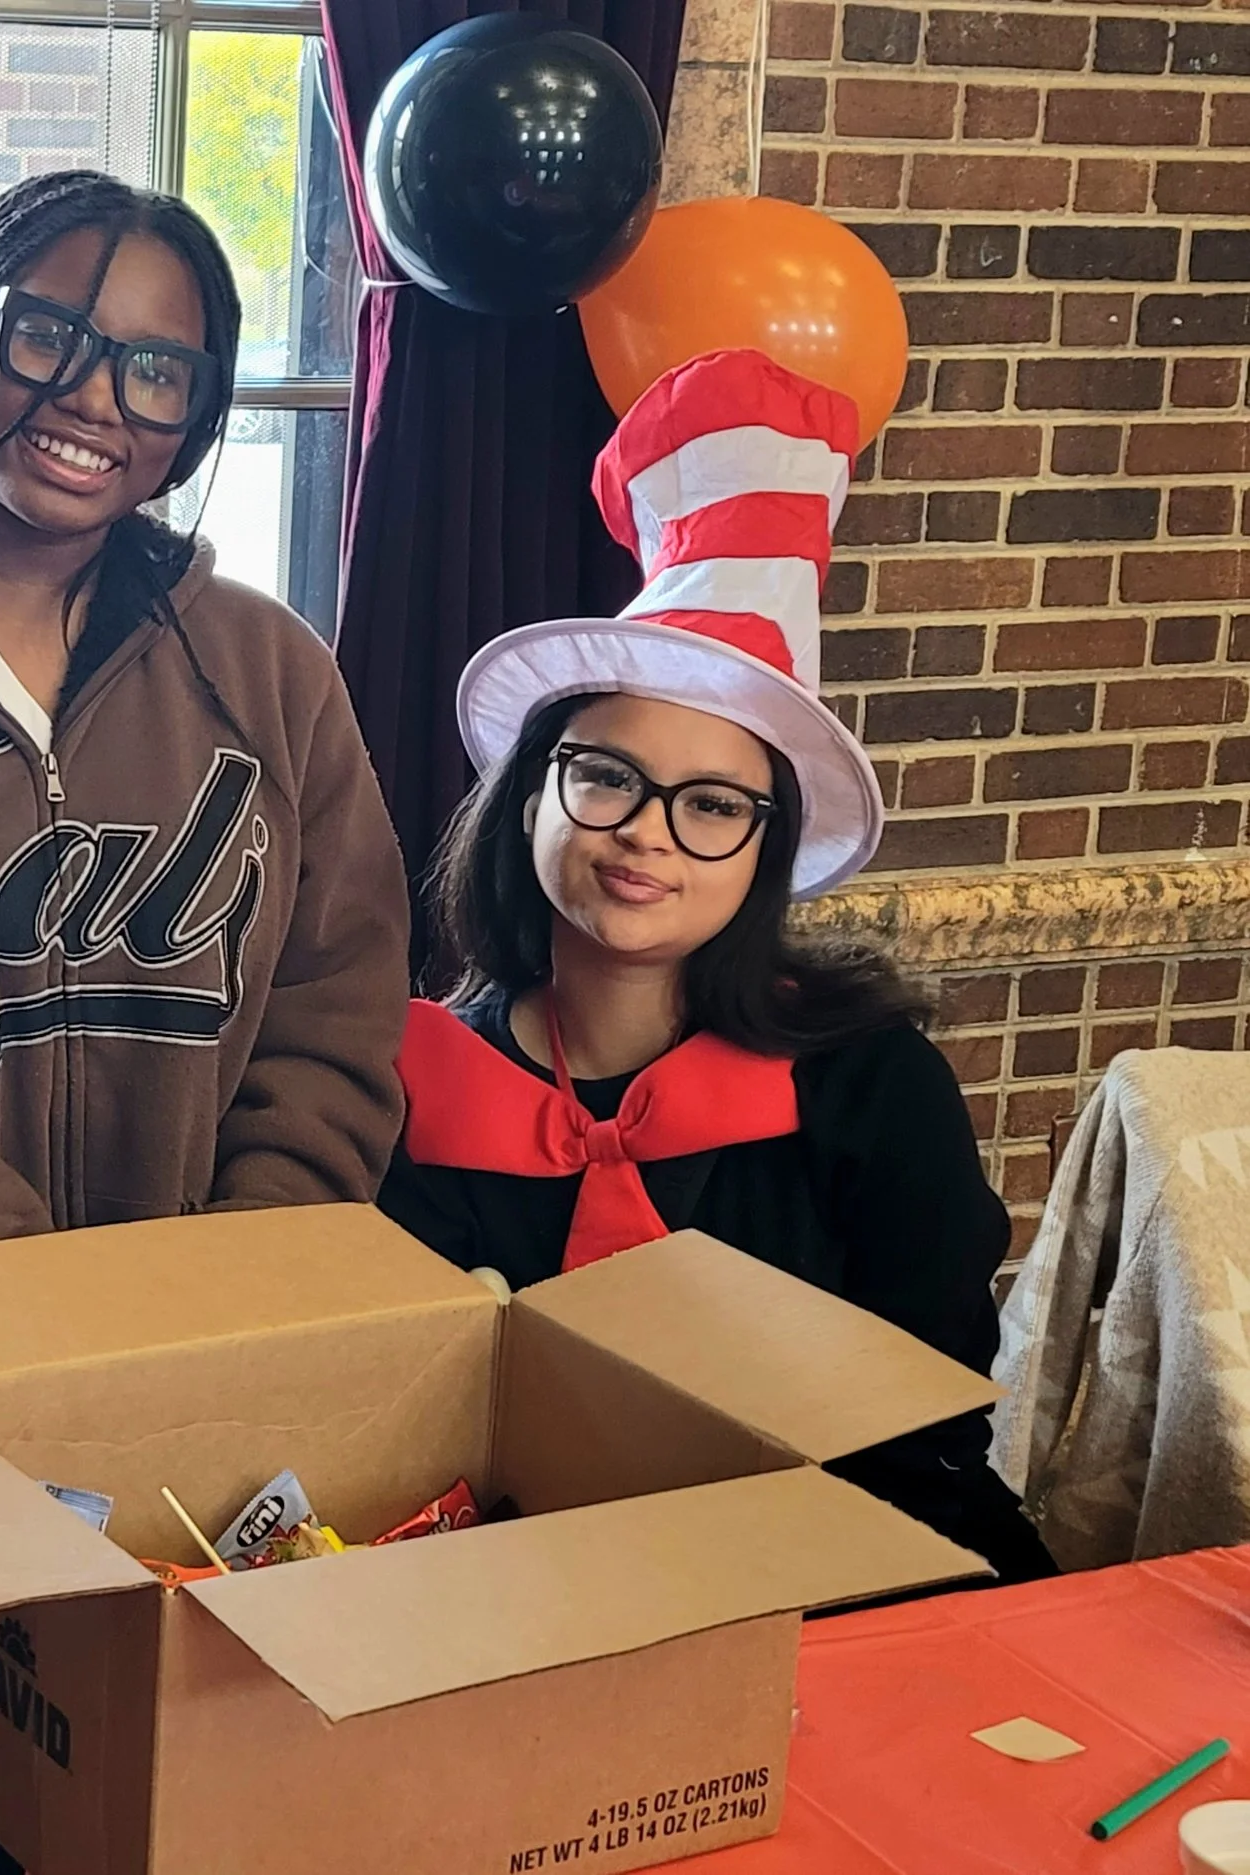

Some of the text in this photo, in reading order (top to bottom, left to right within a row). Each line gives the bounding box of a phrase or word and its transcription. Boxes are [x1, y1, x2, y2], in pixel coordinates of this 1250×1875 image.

[239, 1497, 283, 1545] Fini
[587, 1766, 769, 1828] 4-19.5 OZ CARTONS
[509, 1792, 767, 1874] NET WT 4 LB 14 OZ (2.21kg)
